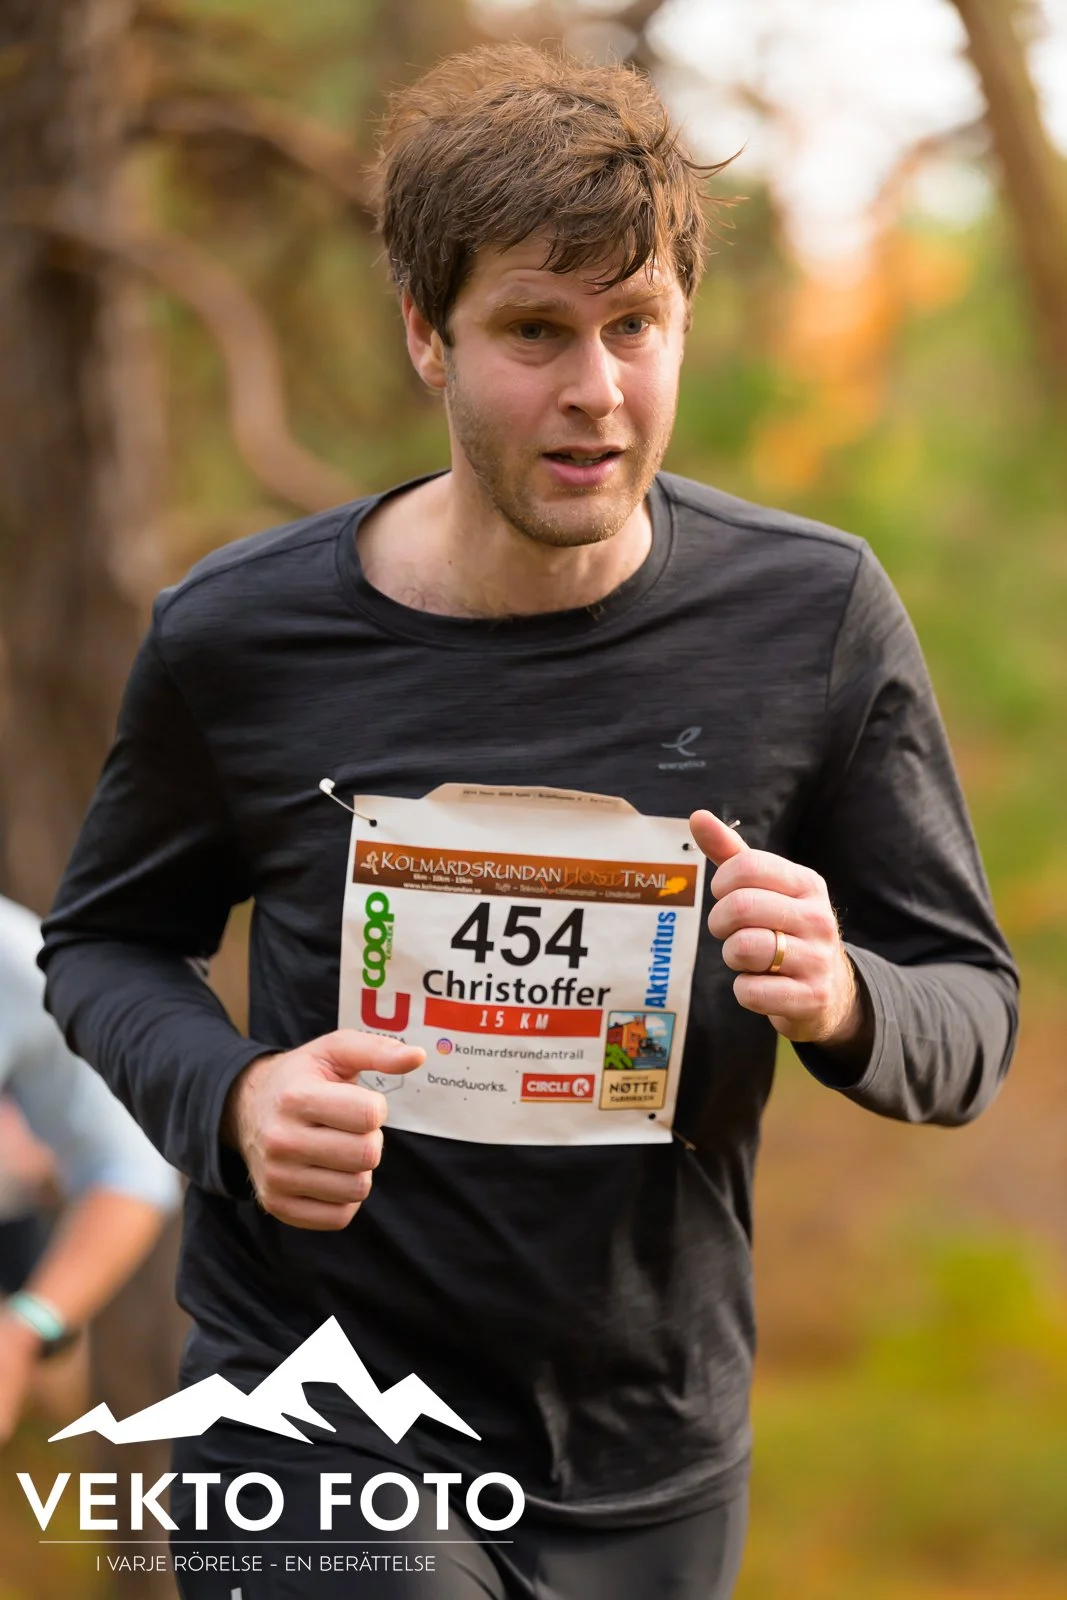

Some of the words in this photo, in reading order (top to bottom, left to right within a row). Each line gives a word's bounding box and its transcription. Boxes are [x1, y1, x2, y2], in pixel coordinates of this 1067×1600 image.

[451, 902, 588, 969] 454
[644, 911, 676, 1009] Aktivitus
[422, 969, 611, 1006] Christoffer
[479, 1010, 505, 1028] 15
[519, 1012, 549, 1030] KM
[454, 1043, 584, 1061] kolmardsrundantrail
[526, 1080, 571, 1093] CIRCLE
[573, 1079, 589, 1096] K
